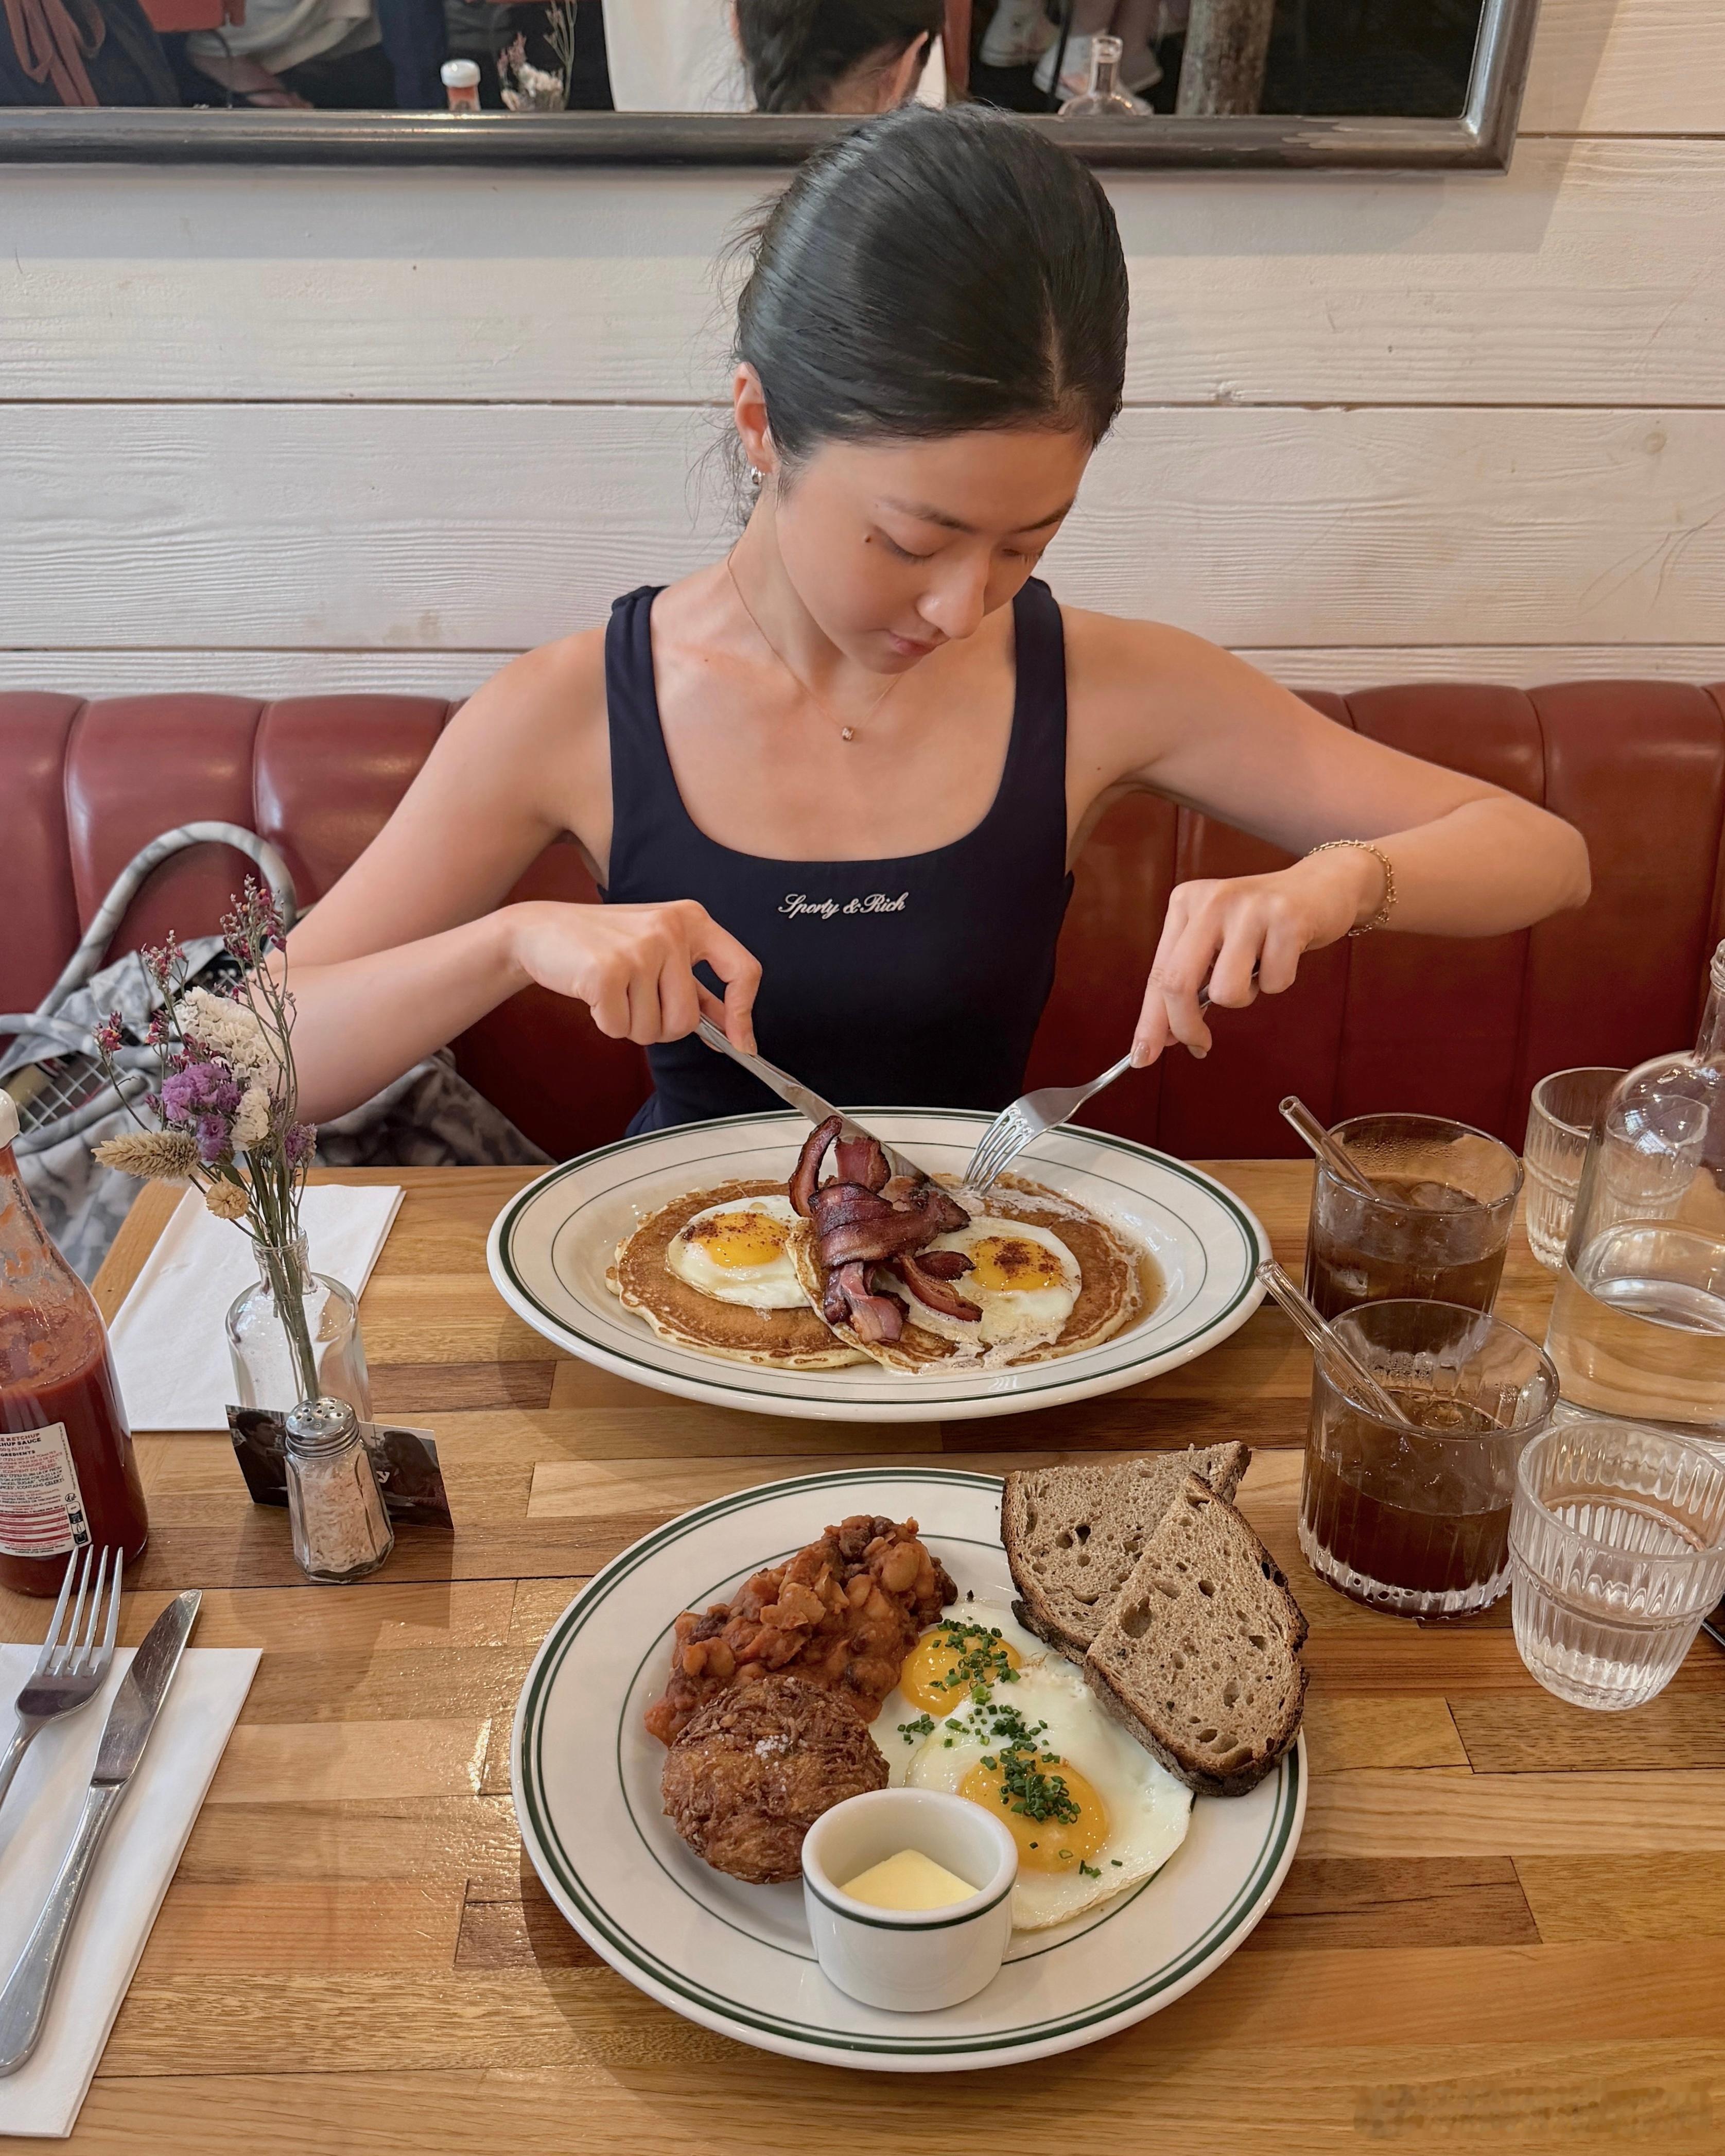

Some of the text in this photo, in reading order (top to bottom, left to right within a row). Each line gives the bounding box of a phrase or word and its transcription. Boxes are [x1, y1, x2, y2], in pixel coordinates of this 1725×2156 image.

[778, 892, 909, 919] Sporty & Rich
[6, 1433, 40, 1441] KETCHUP
